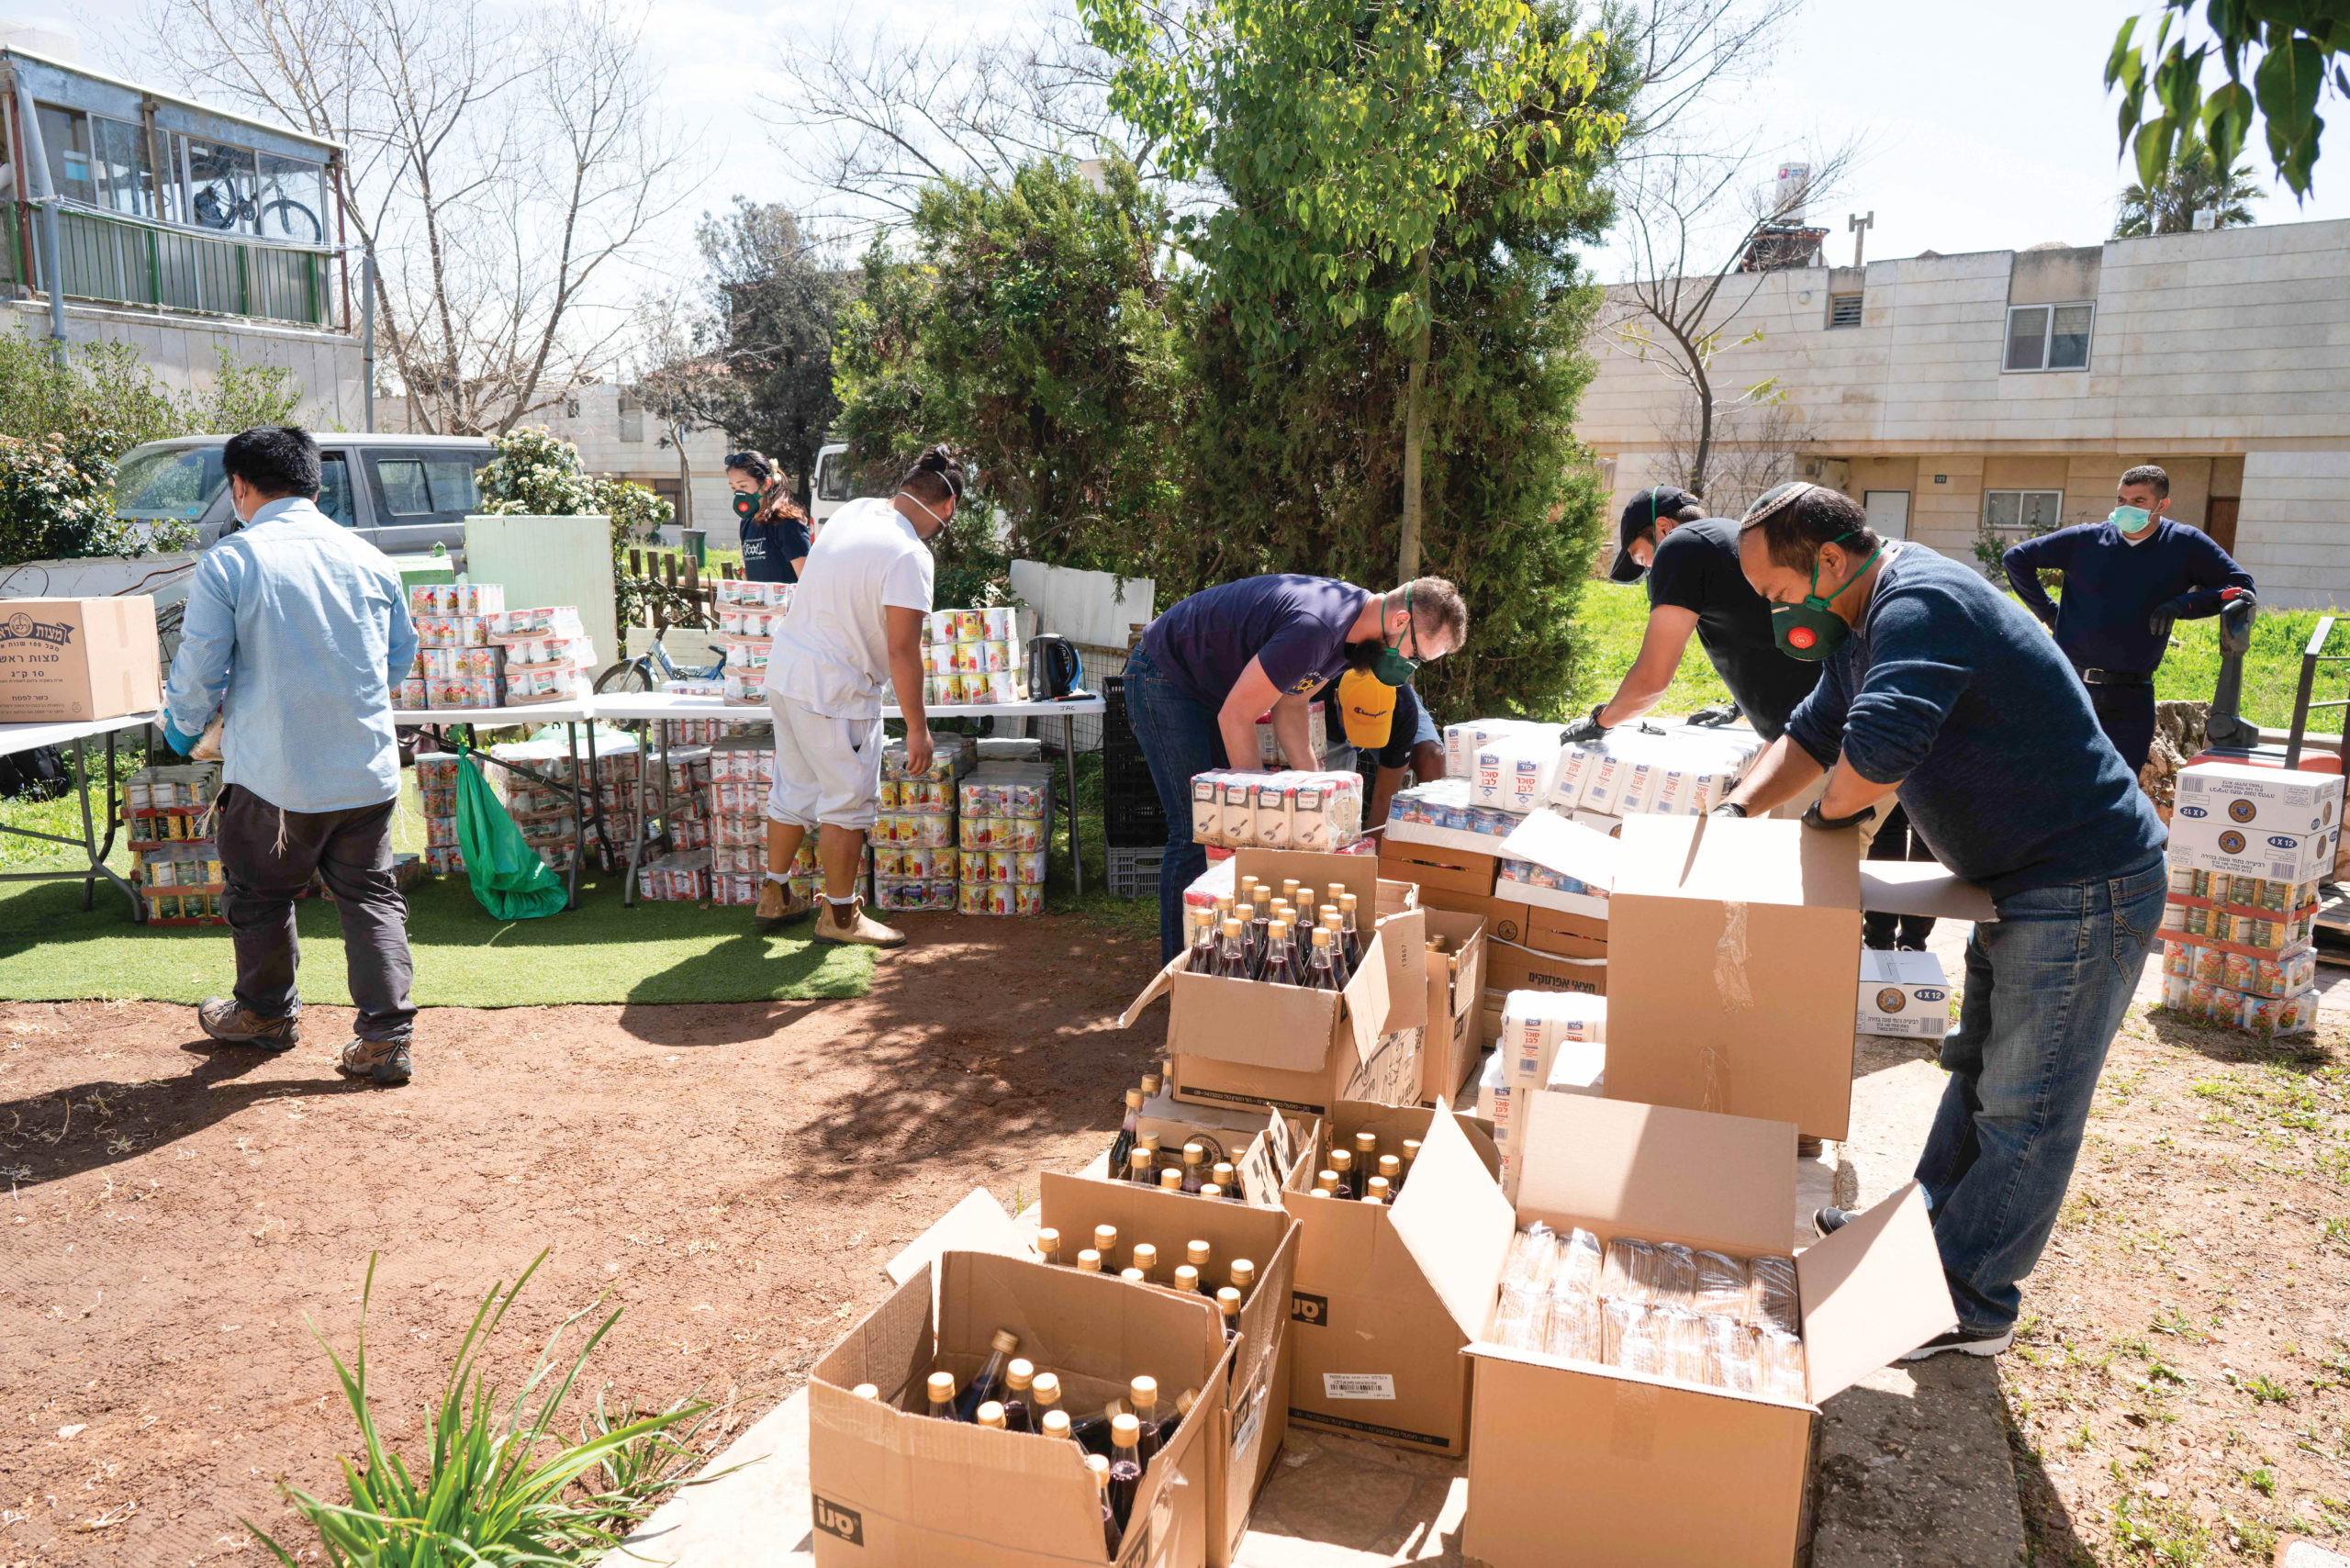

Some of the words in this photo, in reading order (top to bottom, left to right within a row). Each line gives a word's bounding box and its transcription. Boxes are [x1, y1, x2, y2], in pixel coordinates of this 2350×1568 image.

[36, 625, 63, 642] מצות
[29, 655, 59, 663] מצות
[1479, 770, 1499, 778] סוכר
[1482, 778, 1497, 786] לבן
[1517, 785, 1534, 793] לבן
[2284, 839, 2294, 847] 12
[1528, 972, 1570, 989] אפרסקים
[1572, 980, 1595, 992] חצאי
